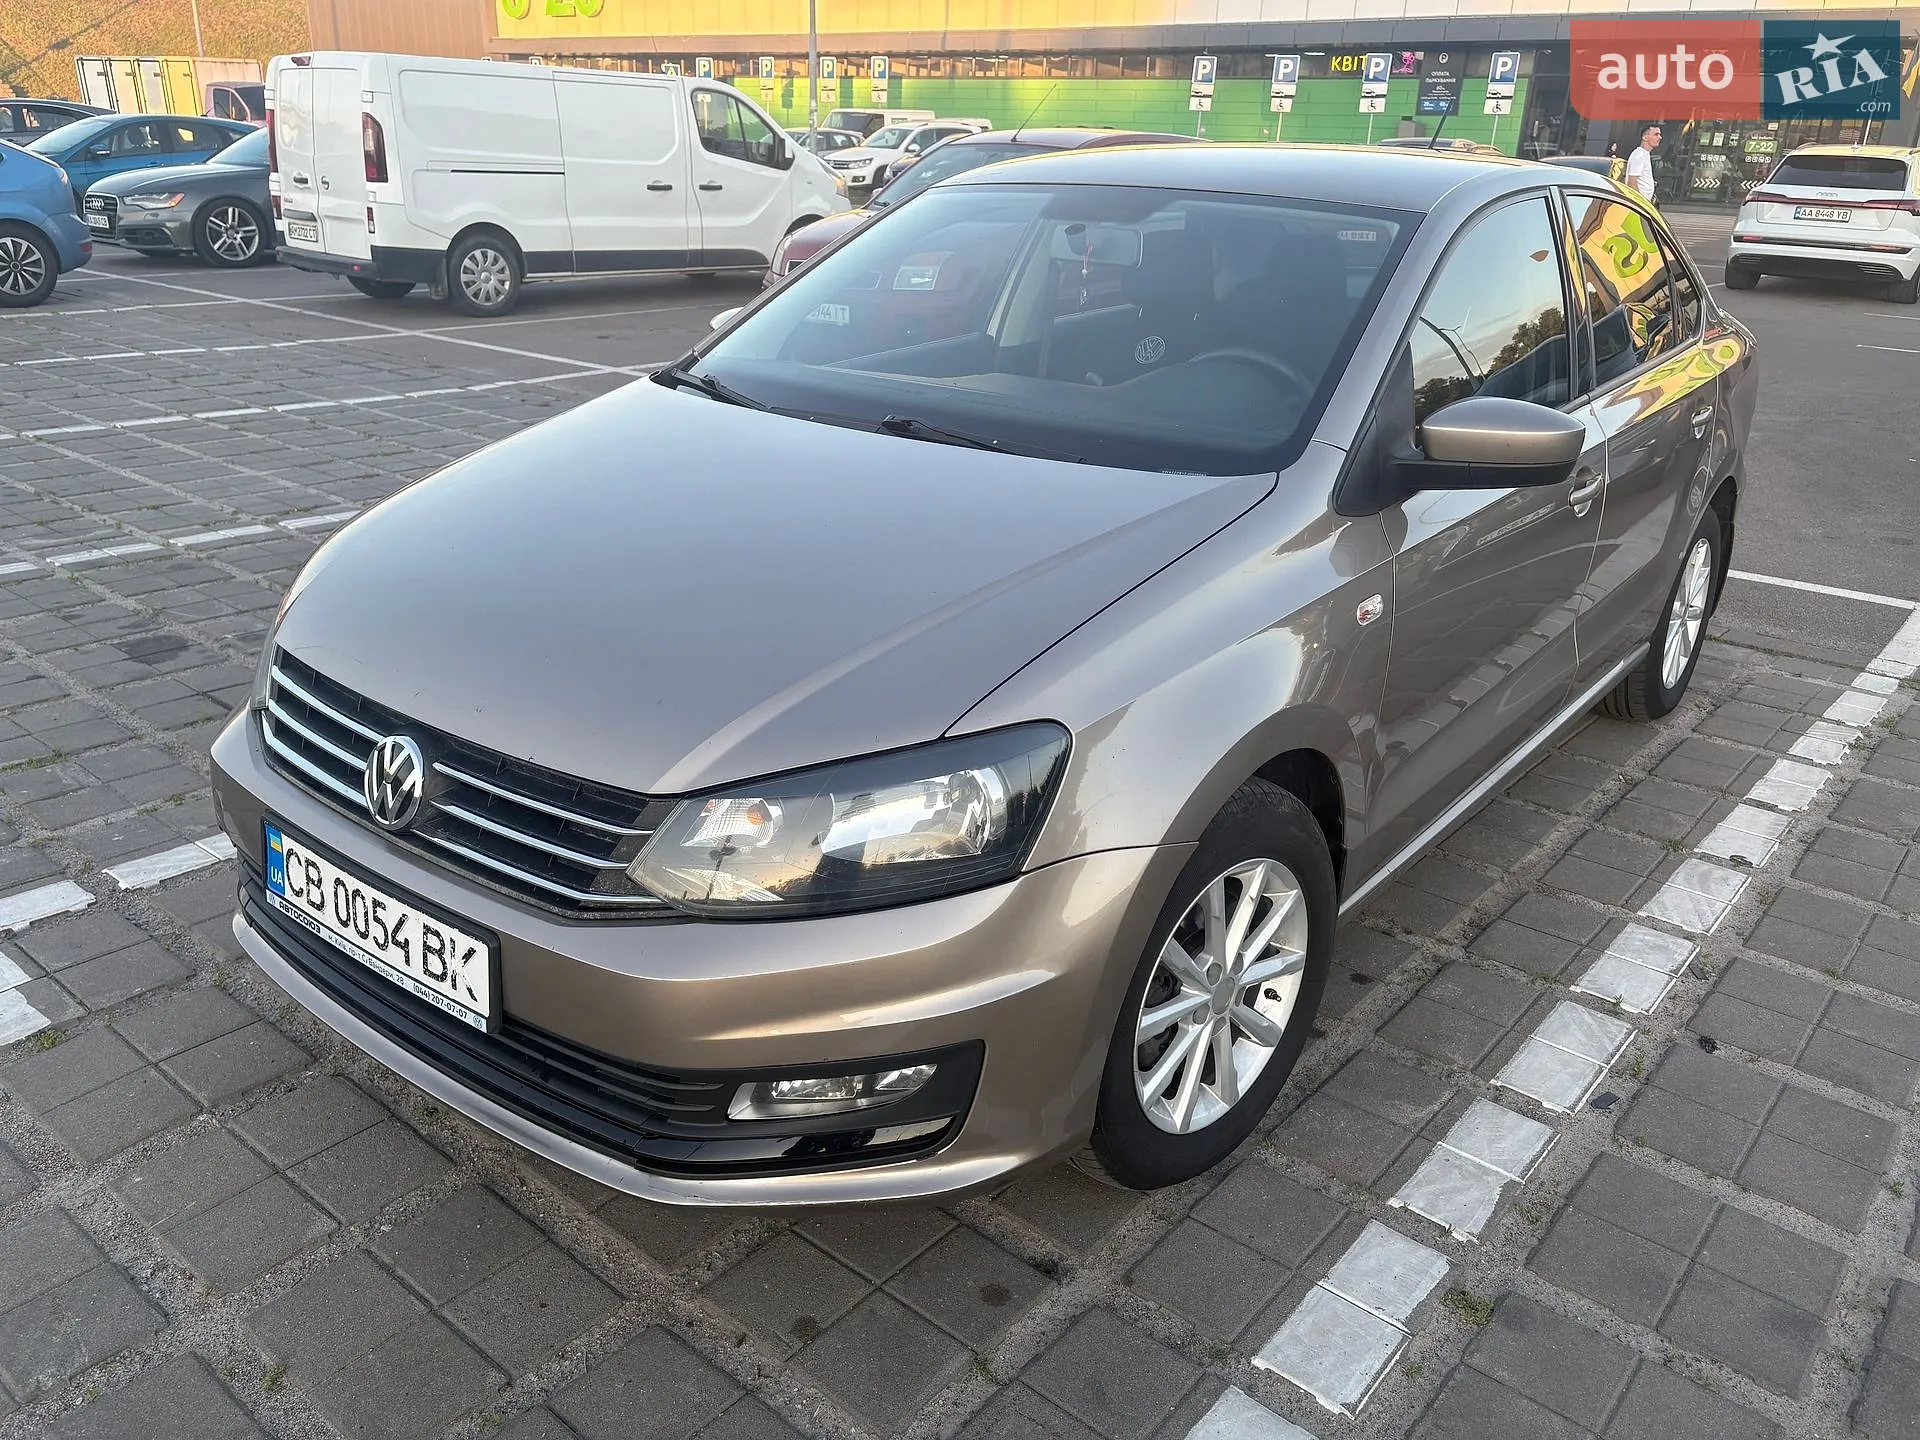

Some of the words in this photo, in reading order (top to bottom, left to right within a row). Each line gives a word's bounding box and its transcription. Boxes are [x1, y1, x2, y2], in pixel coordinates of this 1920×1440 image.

[875, 58, 884, 78] P
[1196, 59, 1212, 81] P
[1277, 59, 1294, 81] P
[1331, 55, 1368, 72] КВІТ
[1367, 57, 1386, 80] P
[1495, 56, 1513, 80] P
[1748, 141, 1775, 153] 7-22
[1800, 208, 1814, 218] AA
[271, 866, 284, 887] UA
[286, 848, 325, 912] CB
[333, 877, 411, 967] 0054
[422, 922, 478, 1003] BK
[279, 901, 321, 934] АВТОСОЮЗ
[413, 982, 430, 1001] (044)
[431, 993, 468, 1019] 207-07-07
